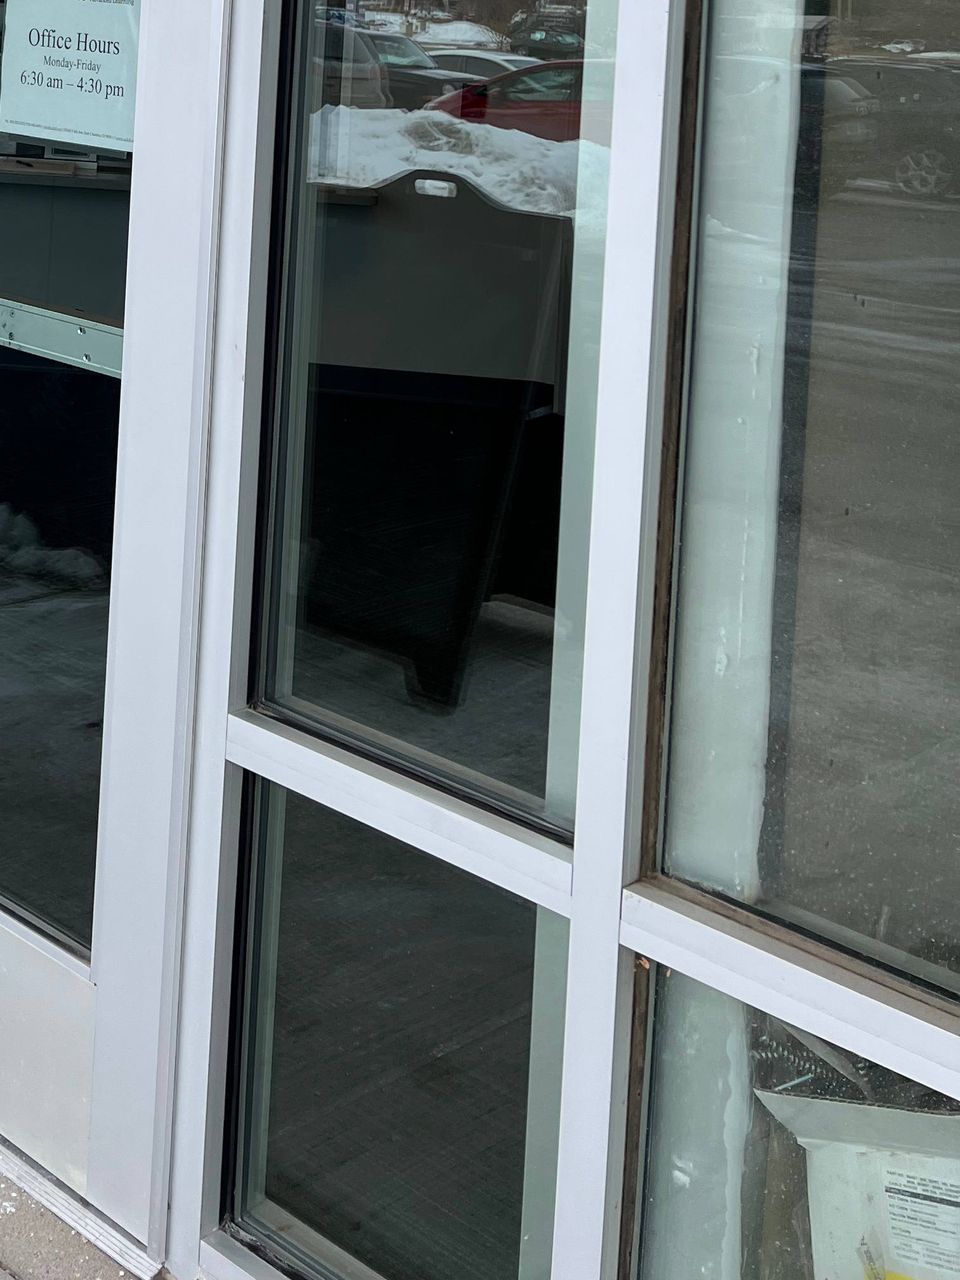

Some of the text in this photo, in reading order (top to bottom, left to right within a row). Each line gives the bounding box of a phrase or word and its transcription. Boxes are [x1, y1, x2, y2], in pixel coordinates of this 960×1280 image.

[28, 27, 120, 55] Office Hours
[43, 55, 101, 74] Monday-Friday
[20, 70, 44, 87] 6:30
[46, 77, 63, 90] am
[77, 76, 102, 94] 4:30
[105, 84, 124, 99] pm
